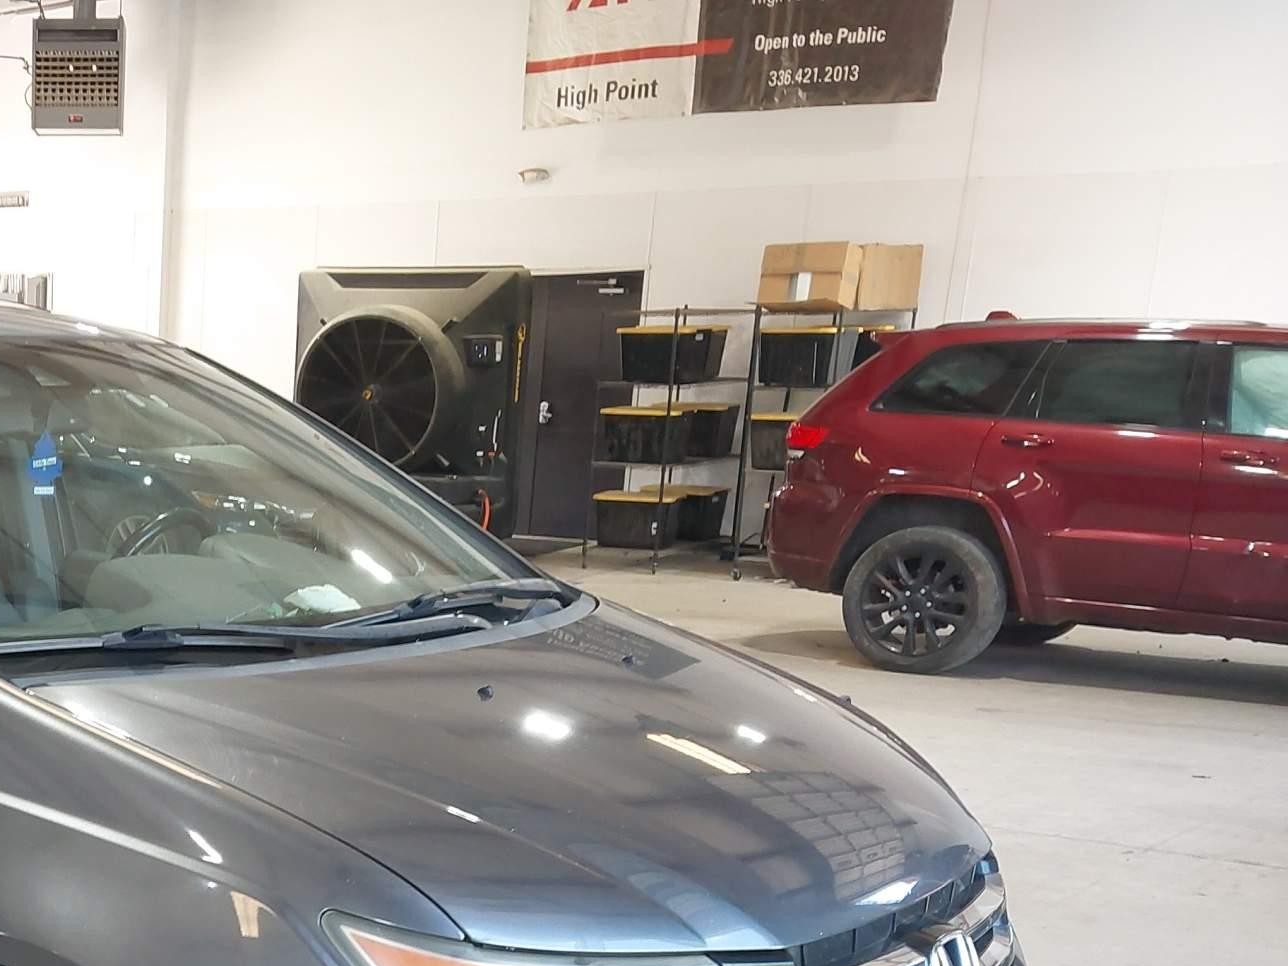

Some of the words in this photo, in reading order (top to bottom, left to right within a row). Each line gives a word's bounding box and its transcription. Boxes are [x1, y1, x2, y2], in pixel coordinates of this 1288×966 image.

[754, 34, 790, 55] Open
[792, 33, 806, 48] to
[809, 29, 833, 46] the
[836, 26, 887, 45] Public
[767, 64, 860, 88] 336.421.2013
[556, 83, 598, 110] High
[605, 78, 658, 102] Point
